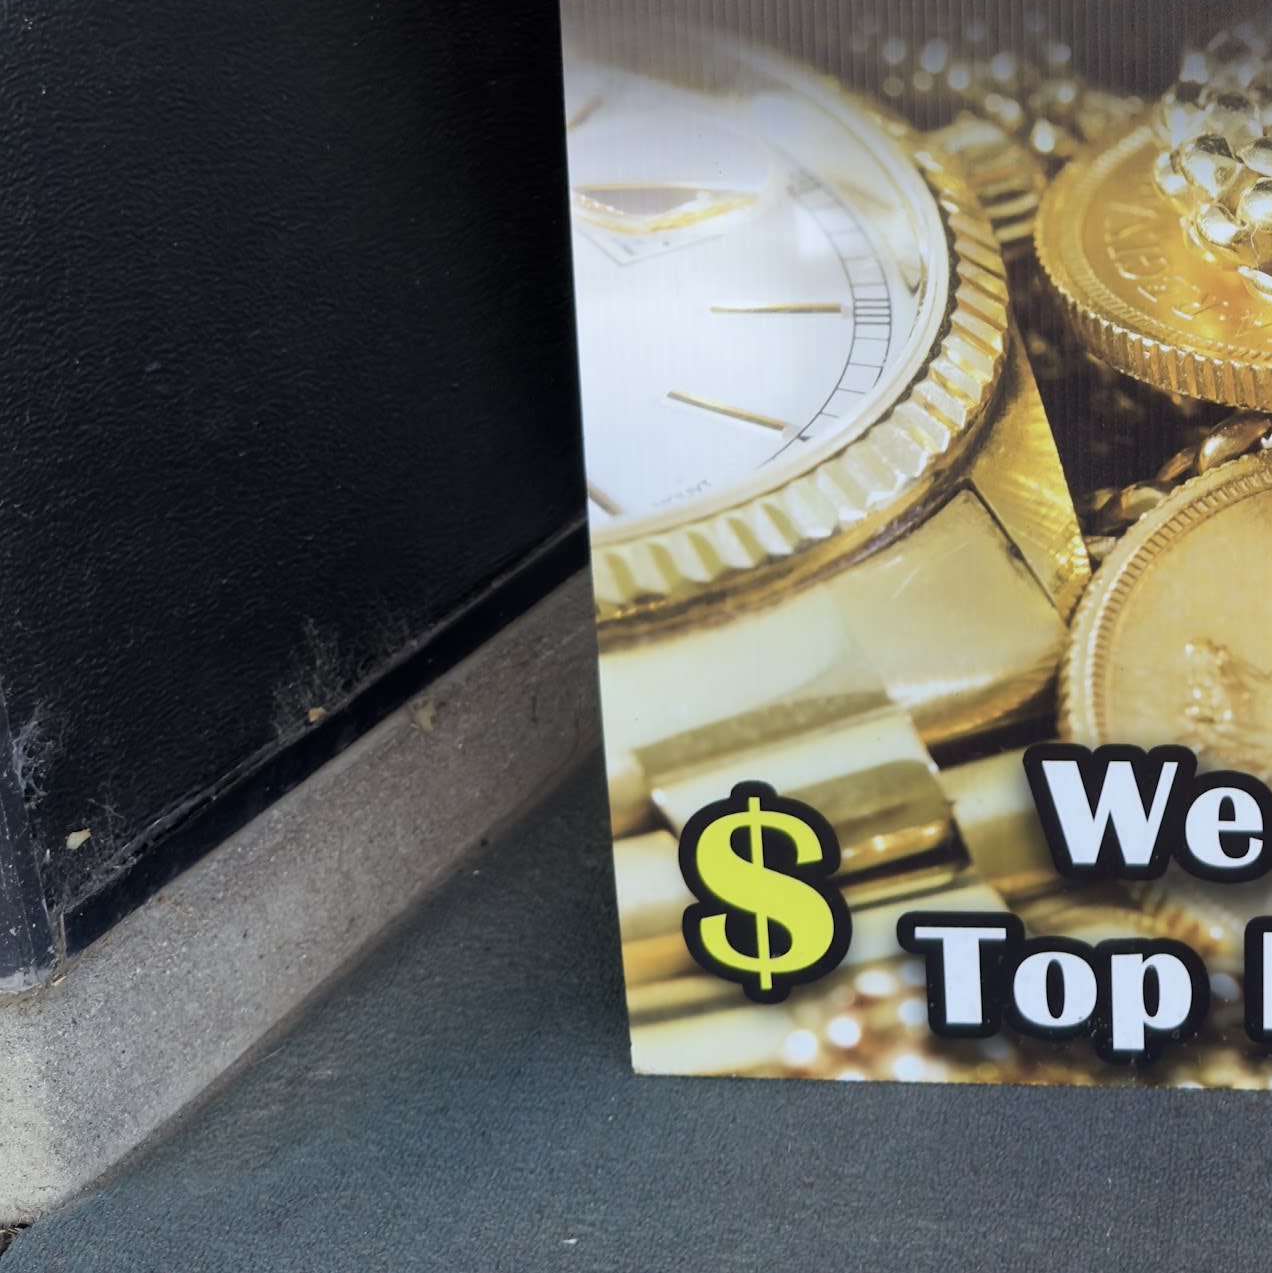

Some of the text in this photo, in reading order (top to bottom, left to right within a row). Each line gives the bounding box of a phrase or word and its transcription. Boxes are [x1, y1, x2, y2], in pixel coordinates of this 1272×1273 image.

[1042, 759, 1264, 868] We
[696, 797, 833, 990] $
[914, 925, 1193, 1053] Top
